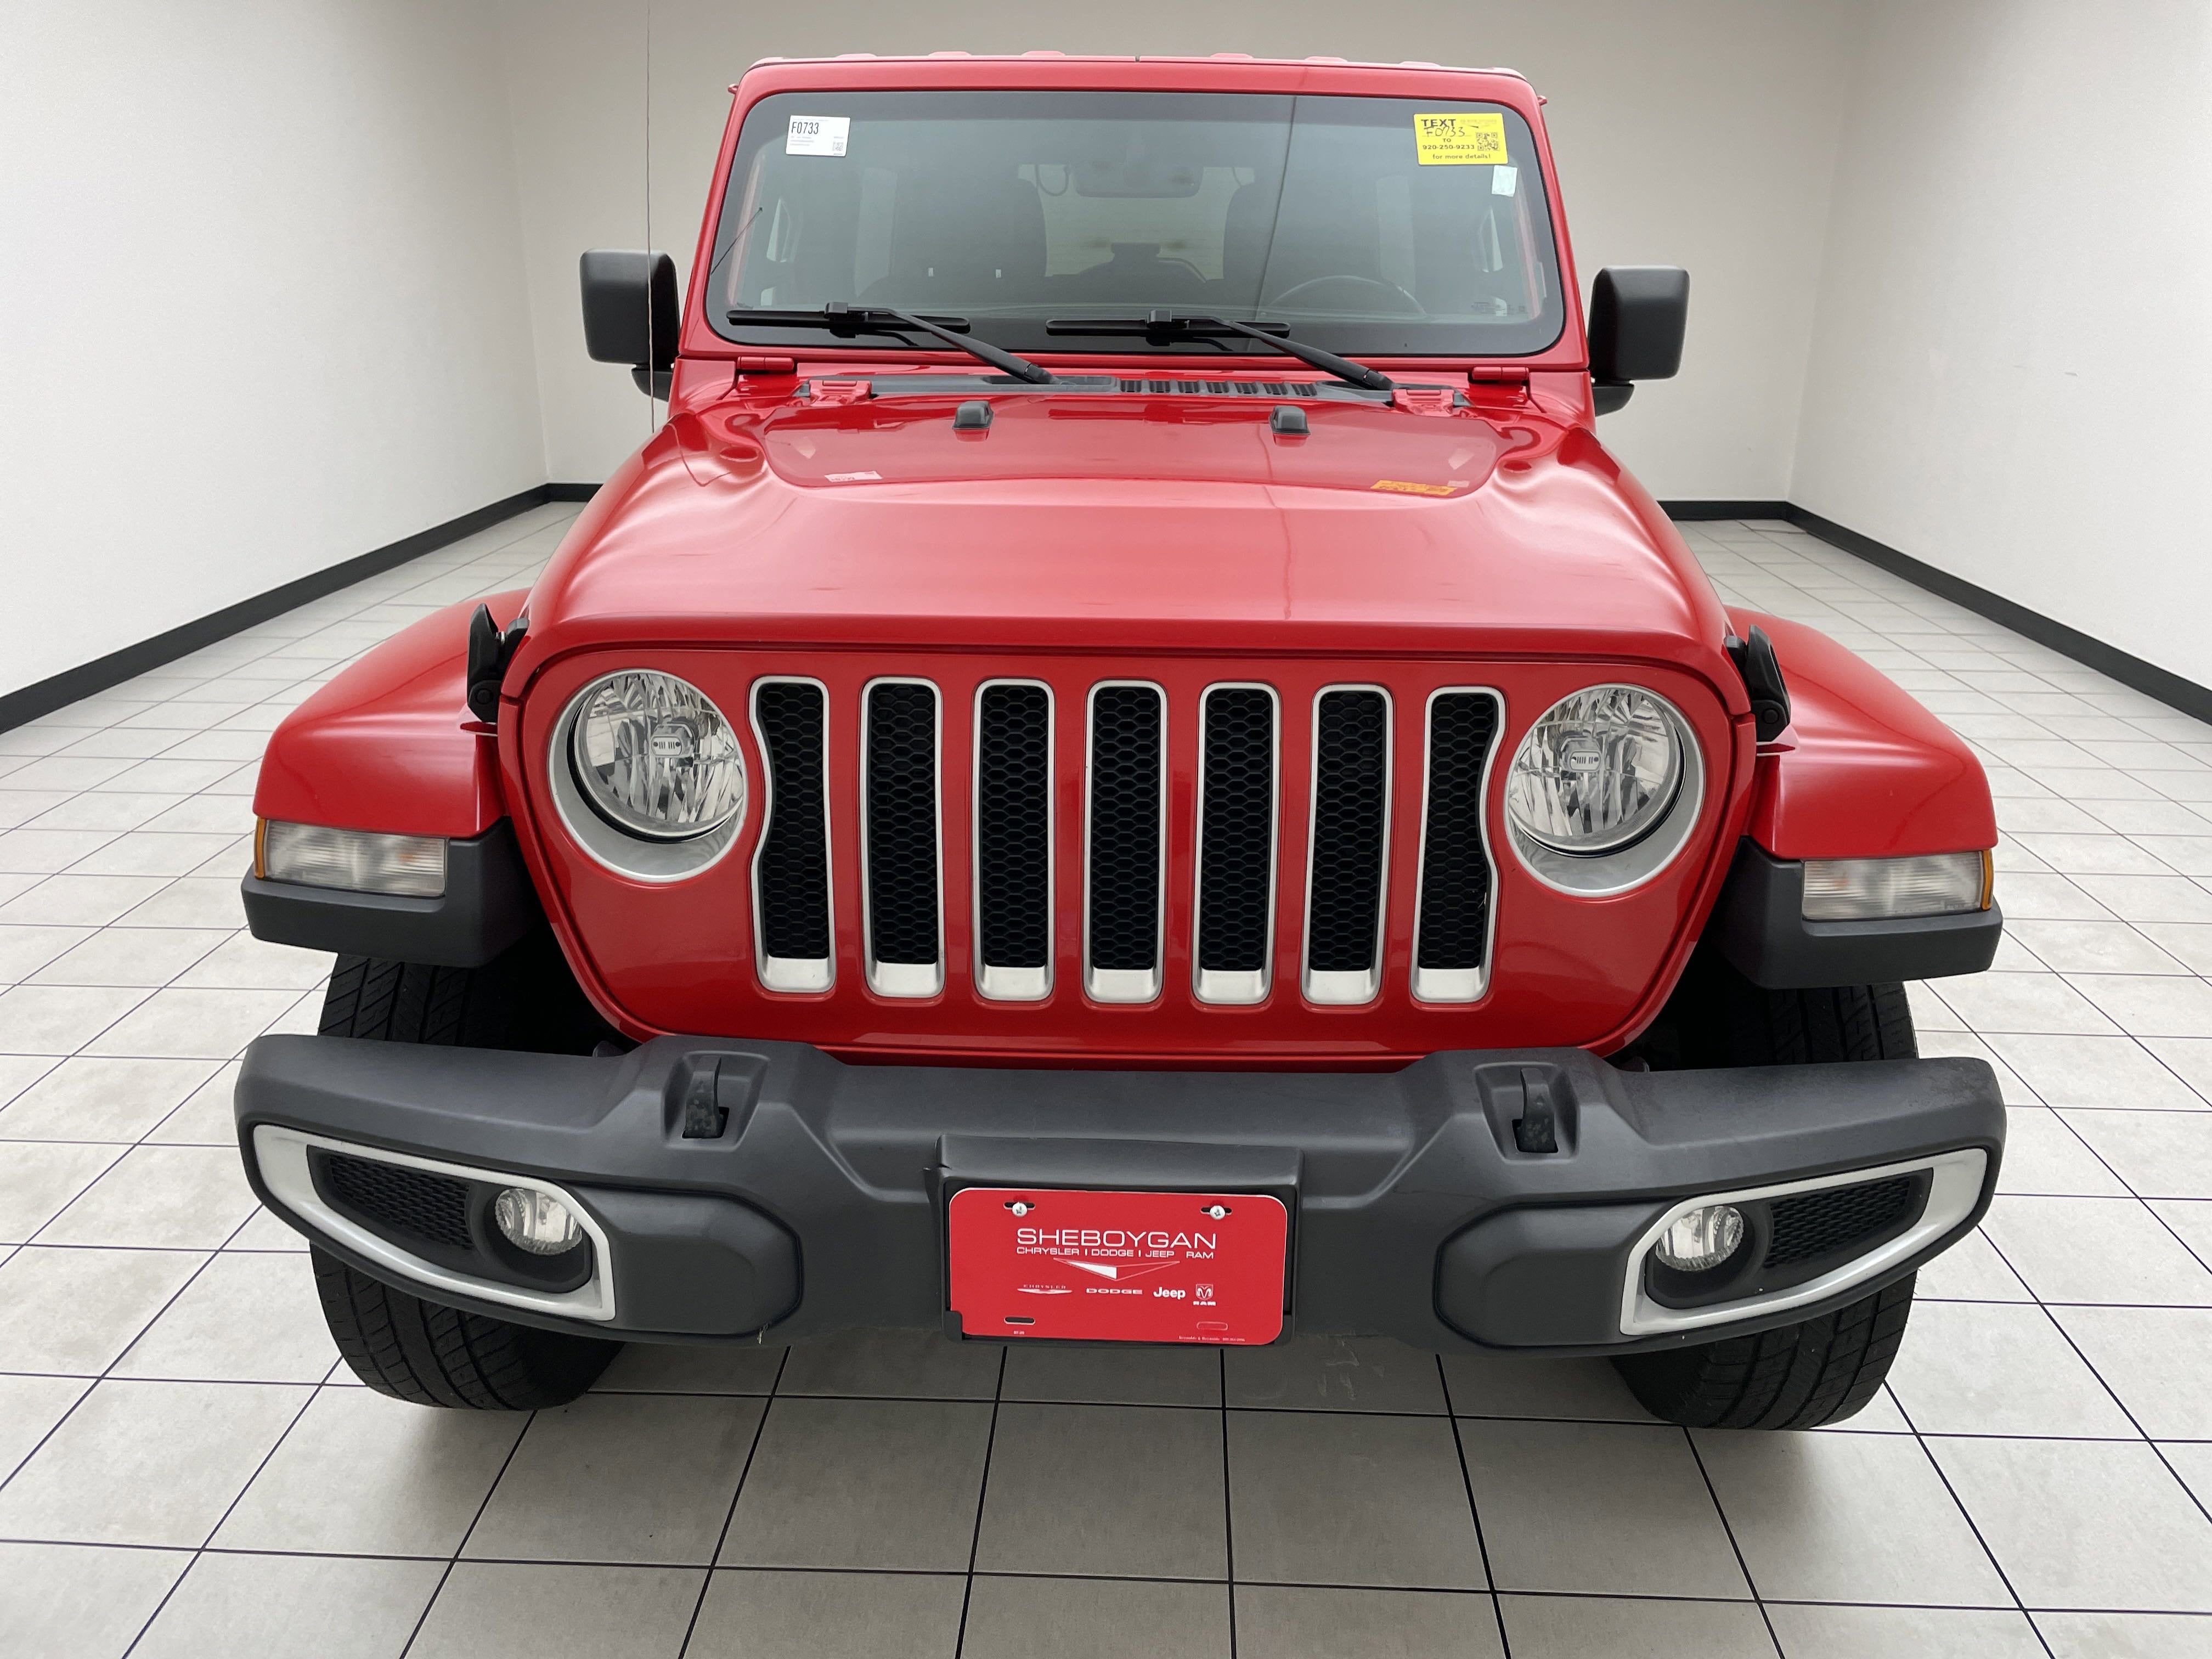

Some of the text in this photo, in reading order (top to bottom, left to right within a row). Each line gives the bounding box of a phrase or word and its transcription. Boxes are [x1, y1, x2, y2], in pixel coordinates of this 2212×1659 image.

[791, 121, 819, 134] F0733
[1420, 119, 1456, 127] TEXT
[1017, 1228, 1217, 1250] SHEBOYGAN
[1016, 1246, 1080, 1256] CHRYSLER
[1091, 1248, 1135, 1257] DODGE
[1145, 1250, 1175, 1258] JEEP
[1186, 1251, 1215, 1260] RAM
[1153, 1286, 1186, 1300] Jeep
